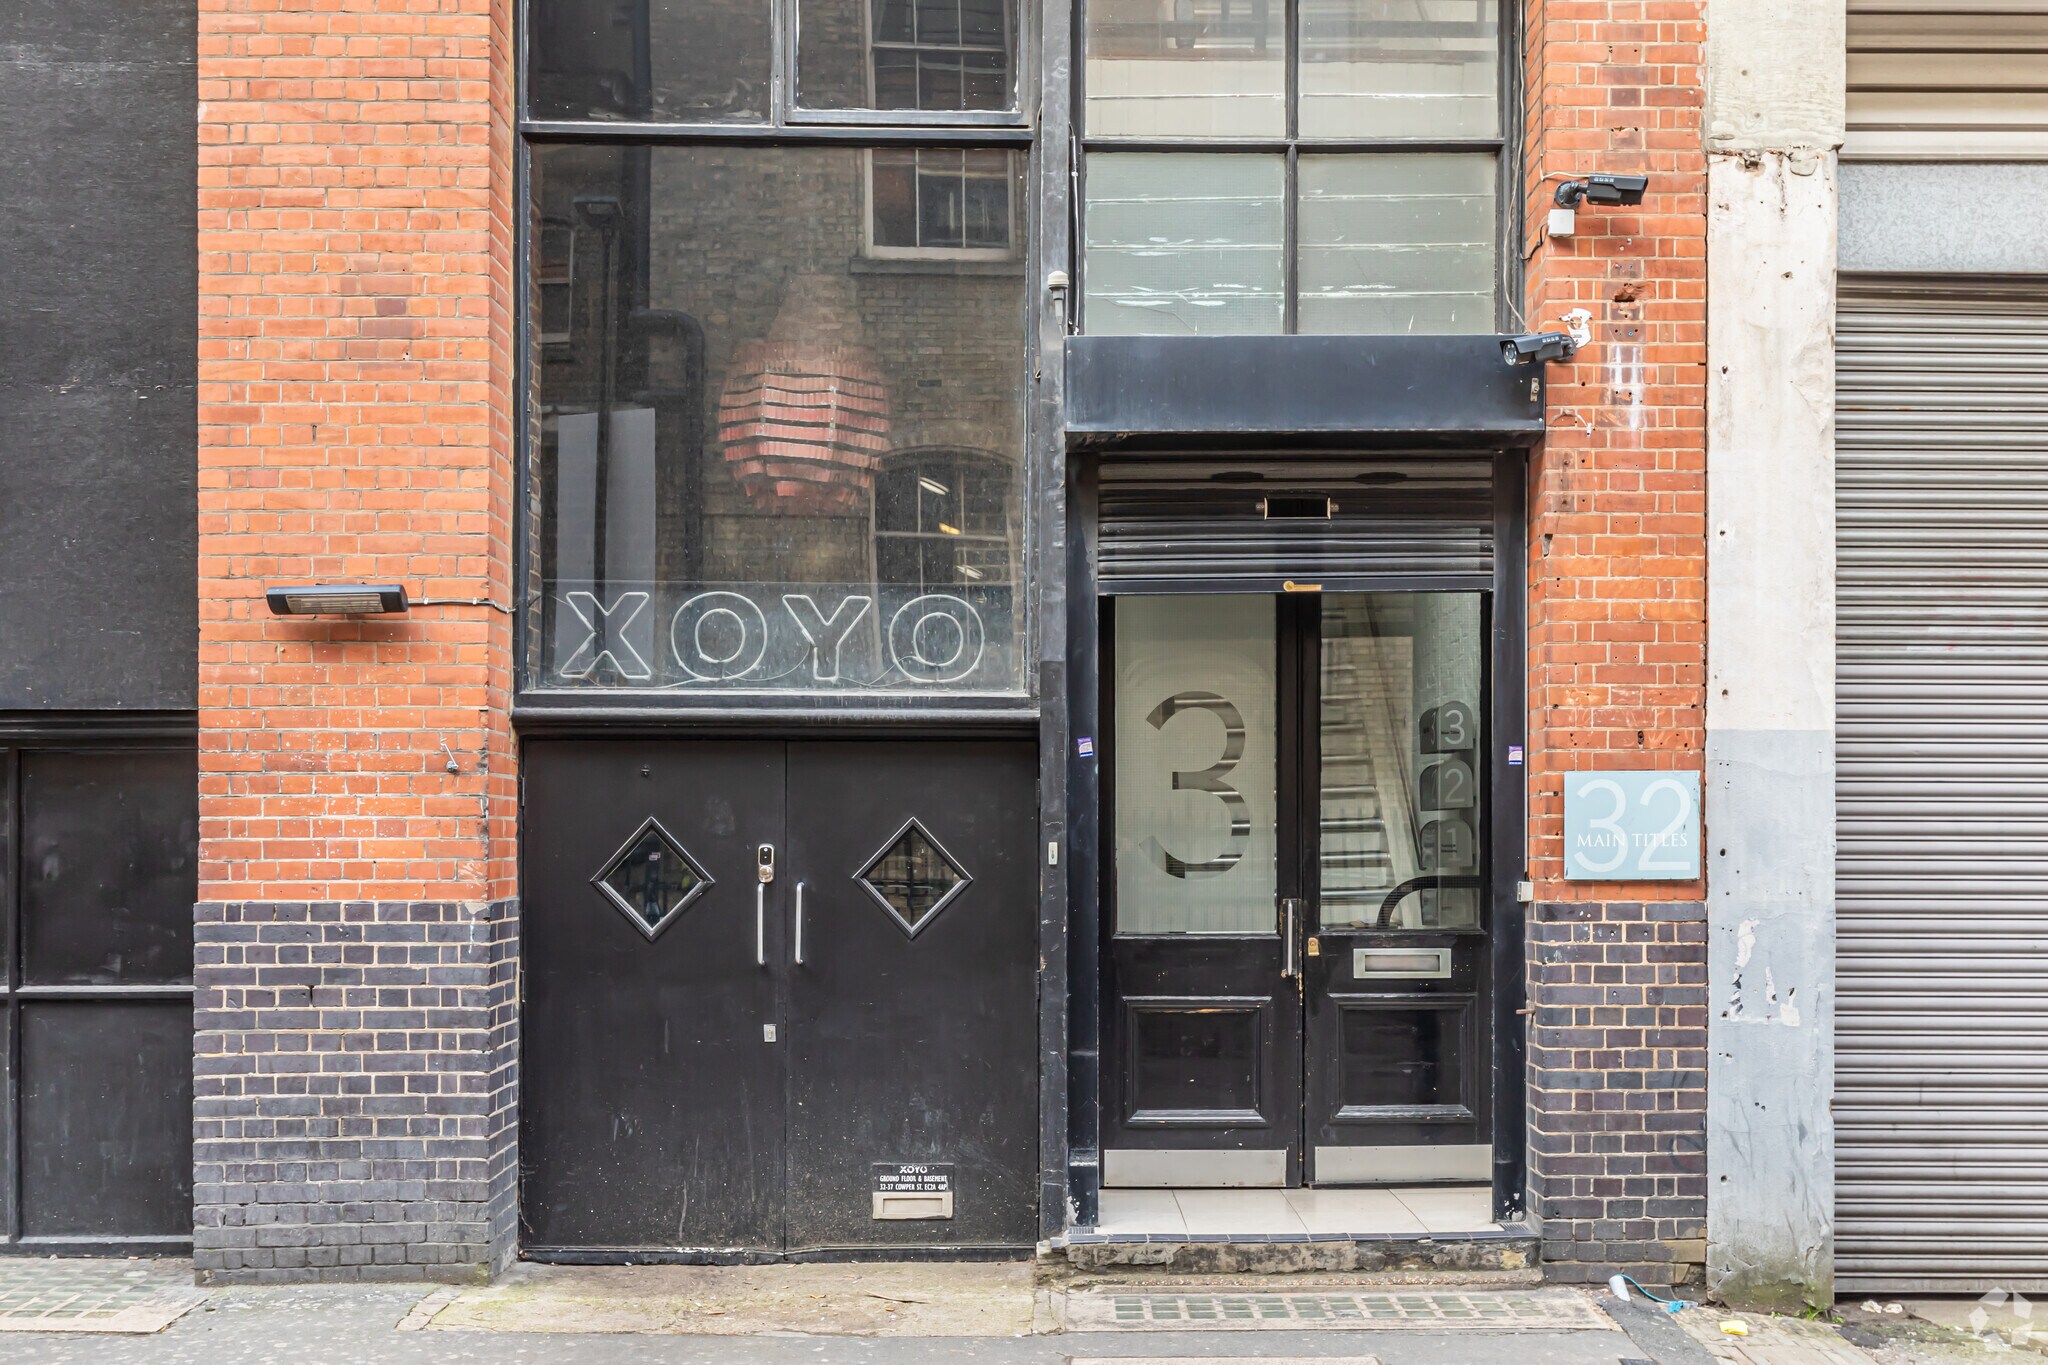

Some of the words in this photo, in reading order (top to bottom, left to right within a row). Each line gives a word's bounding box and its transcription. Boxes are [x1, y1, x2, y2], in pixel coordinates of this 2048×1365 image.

[558, 591, 985, 683] XOYO
[1444, 709, 1465, 744] 3
[1138, 690, 1251, 883] 3
[1444, 768, 1465, 802] 2
[1574, 778, 1691, 873] 32
[1577, 833, 1626, 847] MAIN
[1632, 833, 1688, 847] TITLES
[1446, 827, 1461, 861] 1
[899, 1165, 927, 1173] XOYO
